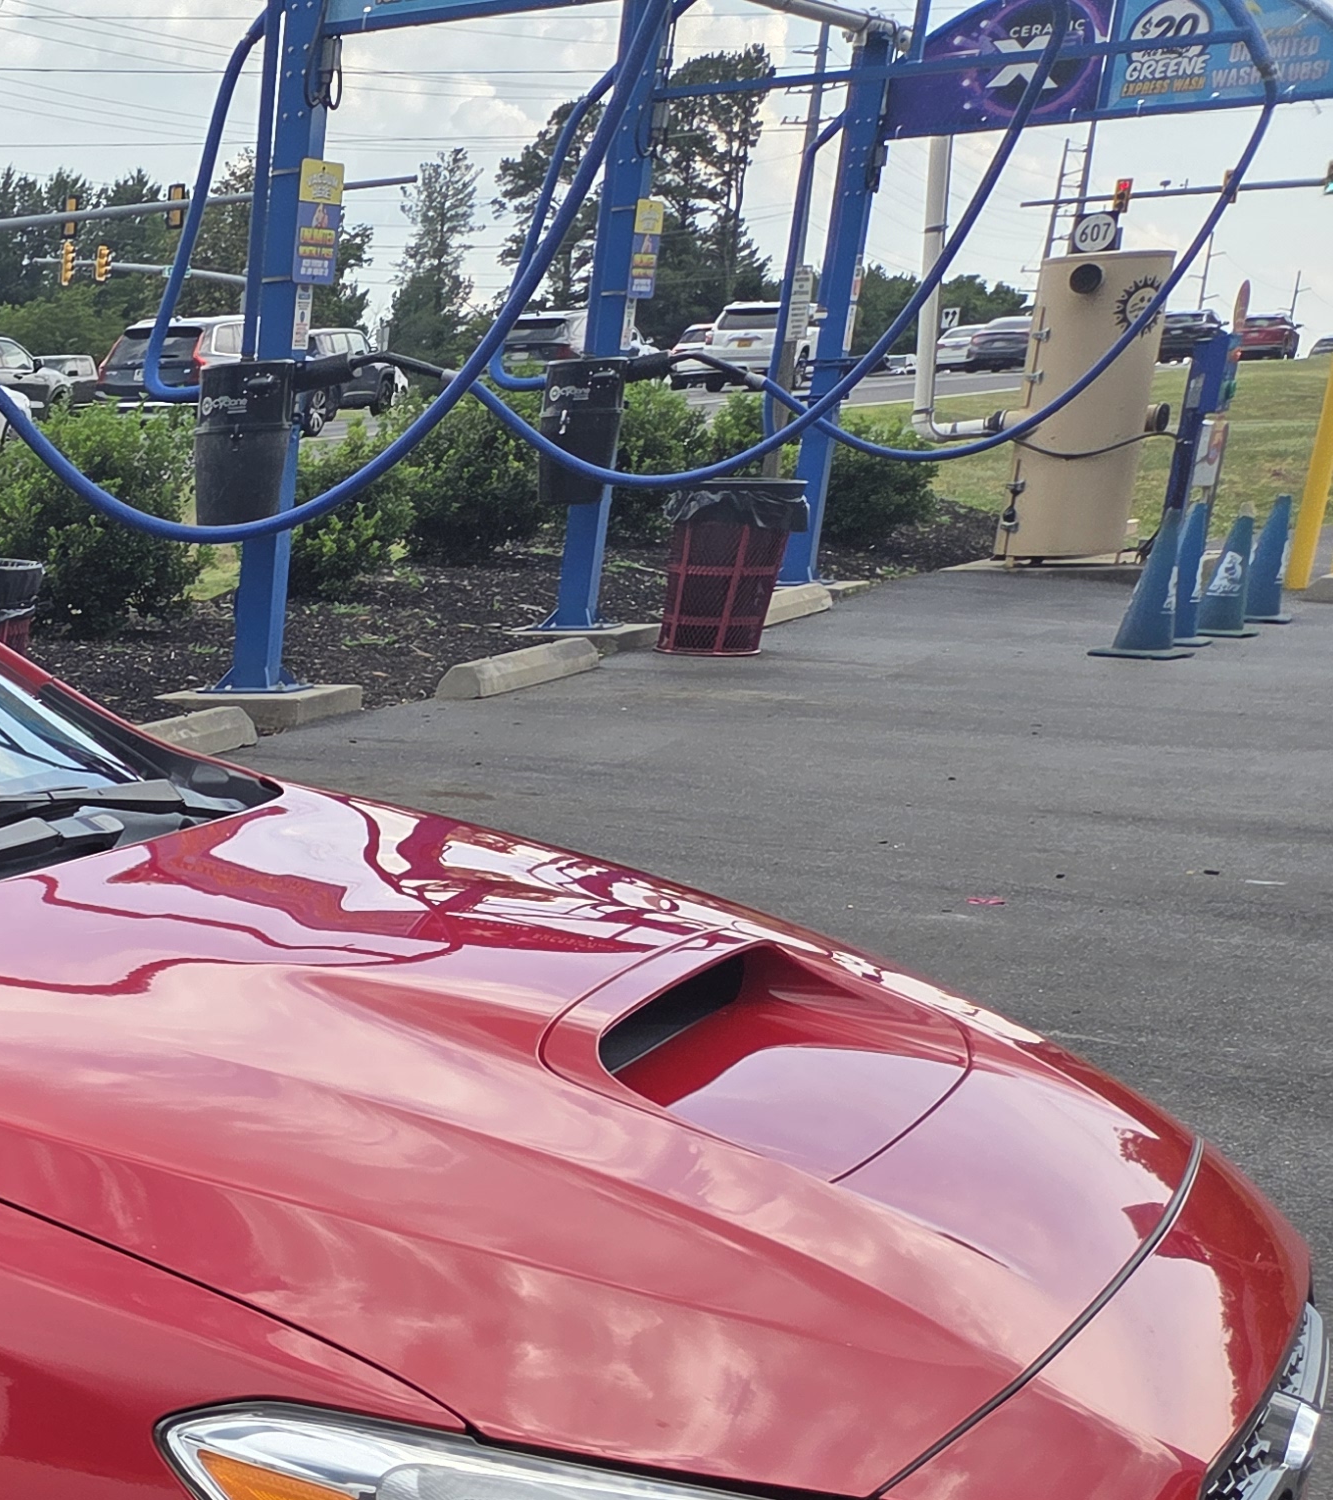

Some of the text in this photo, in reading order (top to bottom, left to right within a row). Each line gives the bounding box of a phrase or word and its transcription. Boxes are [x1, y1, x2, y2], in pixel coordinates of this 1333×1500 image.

[1009, 19, 1086, 38] CERAIC
[1125, 54, 1211, 81] GREENE
[1121, 76, 1205, 97] EXPRESS WASH
[1079, 222, 1111, 243] 607
